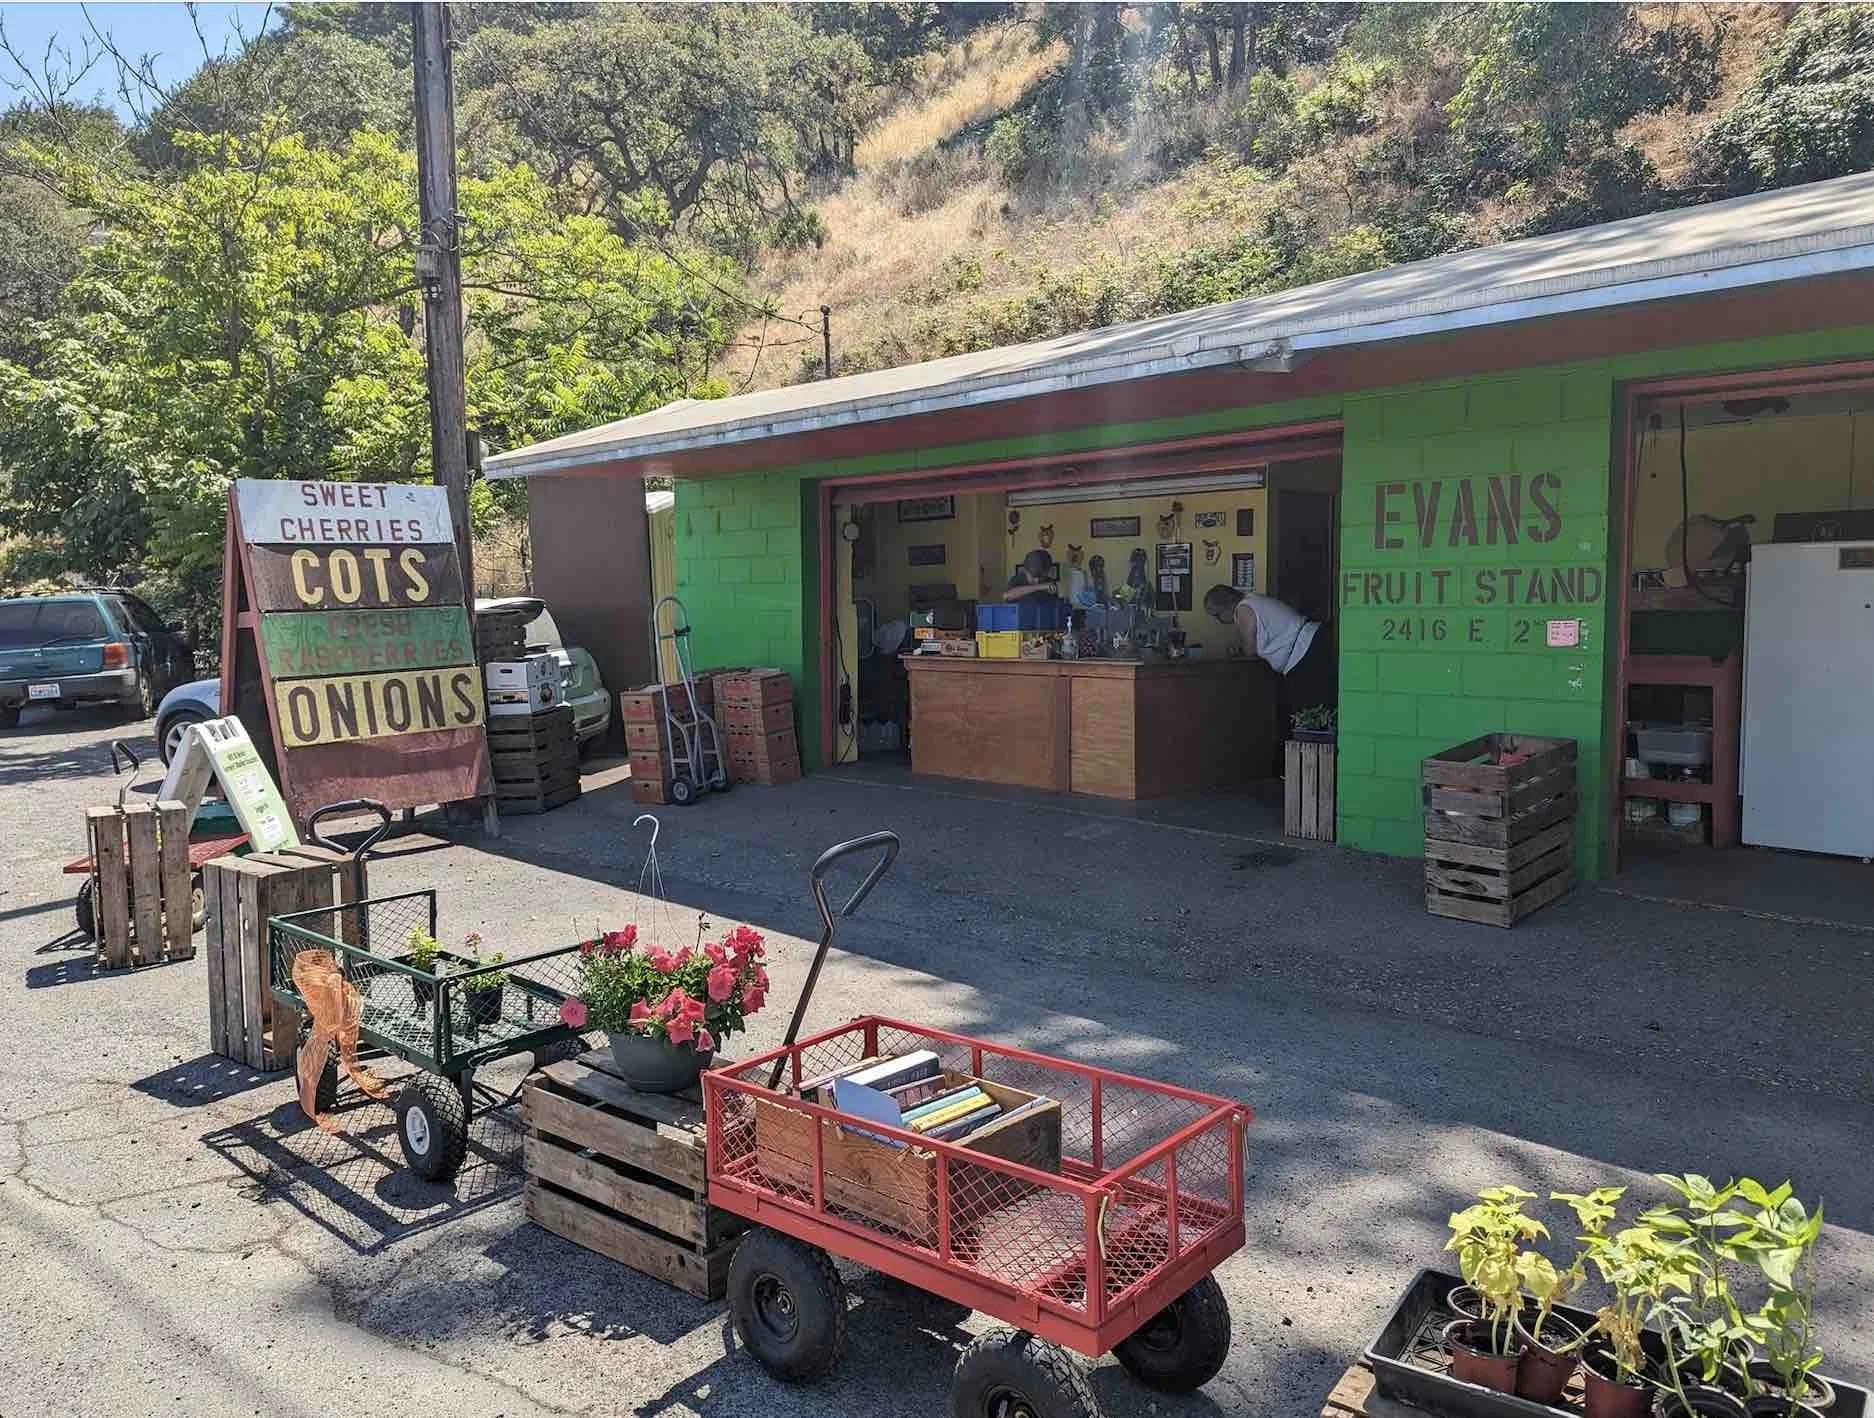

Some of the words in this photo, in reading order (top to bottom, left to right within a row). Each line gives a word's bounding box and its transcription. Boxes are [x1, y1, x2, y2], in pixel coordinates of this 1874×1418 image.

[302, 483, 388, 508] SWEET
[1375, 471, 1562, 551] EVANS
[280, 518, 423, 542] CHERRIES
[291, 548, 431, 605] COTS
[1342, 569, 1451, 606] FRUIT
[1475, 567, 1602, 604] STAND
[1382, 618, 1447, 641] 2416
[288, 673, 477, 743] ONIONS
